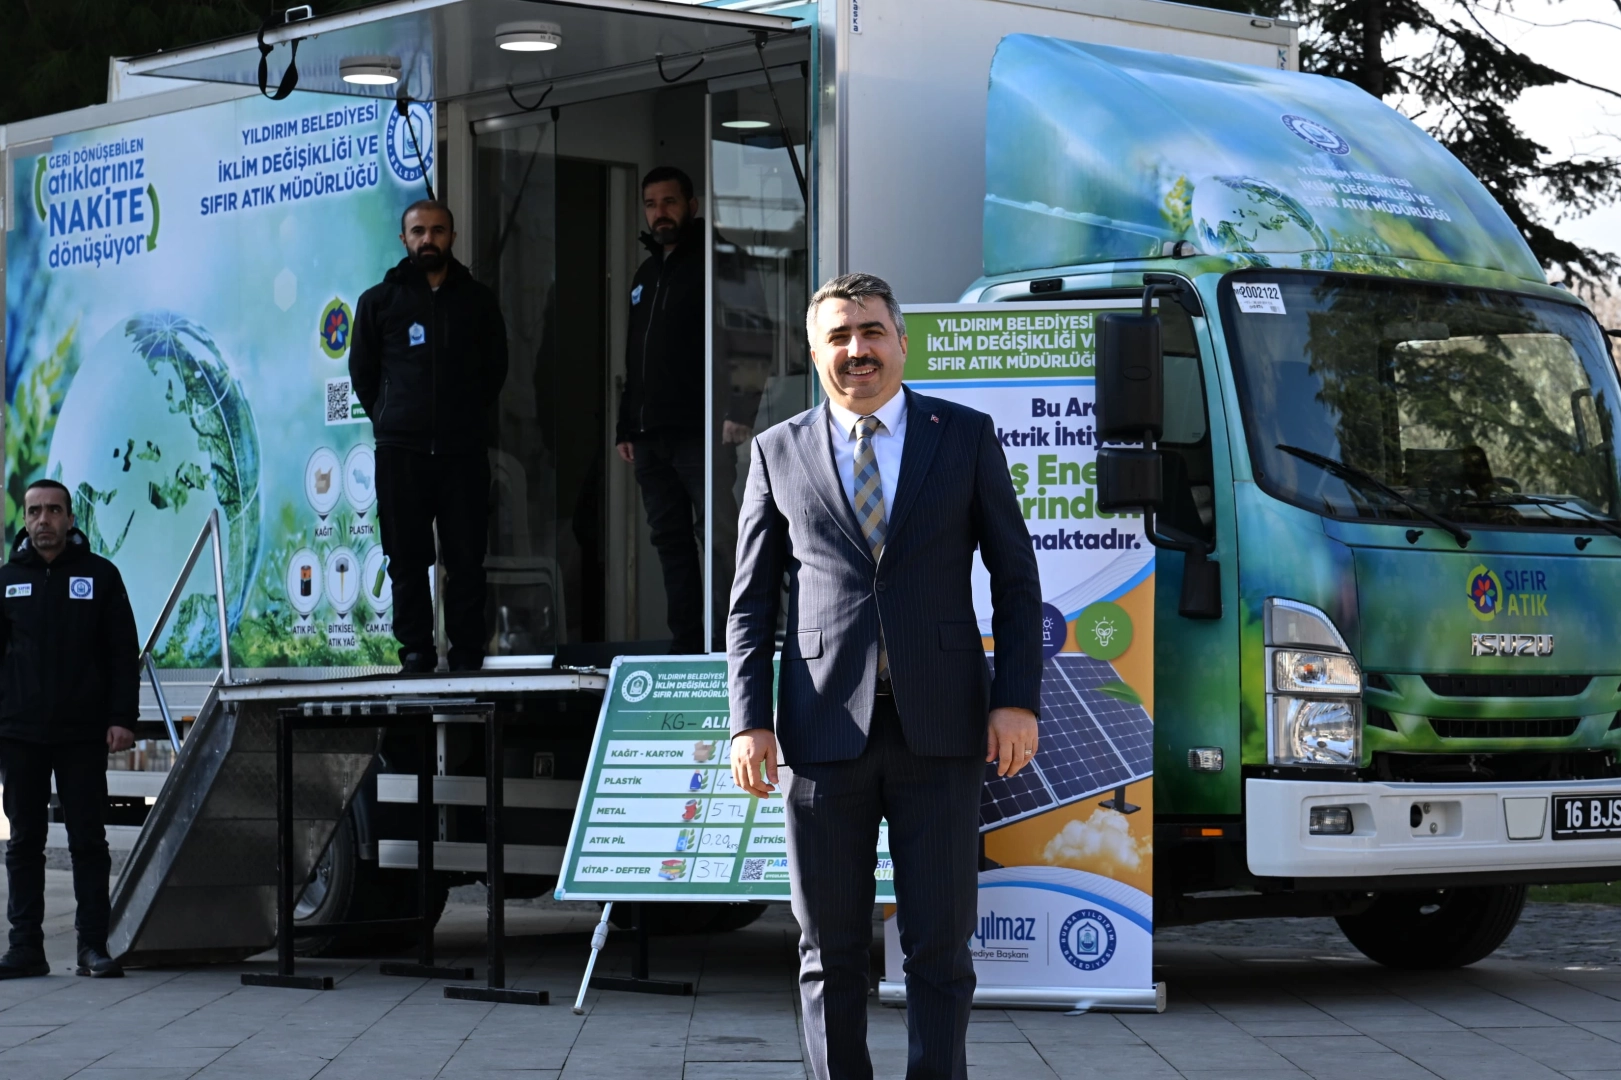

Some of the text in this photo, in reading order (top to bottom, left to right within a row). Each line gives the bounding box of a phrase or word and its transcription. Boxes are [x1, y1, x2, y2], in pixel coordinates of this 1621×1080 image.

[242, 100, 379, 145] YILDIRIM BELEDİYESİ
[49, 138, 144, 169] GERİ DÖNÜŞEBİLEN
[218, 135, 379, 183] İKLİM DEĞİŞİKLİĞİ VE
[48, 158, 144, 196] atıklarınız
[1298, 167, 1413, 188] YILDIRIM BELEDİYESİ
[200, 162, 379, 216] SIFIR ATIK MÜDÜRLÜĞÜ
[1298, 178, 1435, 206] İKLİM DEĞİŞİKLİĞİ VE
[49, 186, 144, 237] NAKİTE
[1303, 195, 1451, 222] SIFIR ATIK MÜDÜRLÜĞÜ
[48, 233, 145, 269] dönüşüyor
[937, 313, 1093, 332] YILDIRIM BELEDİYESİ
[927, 330, 1096, 353] İKLİM DEĞİŞİKLİĞİ V
[927, 356, 966, 371] SIFIR
[968, 355, 1003, 370] ATIK
[1032, 397, 1061, 418] Bu
[314, 526, 333, 537] KAĞIT
[349, 525, 374, 535] PLASTİK
[1504, 570, 1547, 591] SIFIR
[1507, 593, 1549, 617] ATIK
[292, 624, 317, 634] ATIK PİL
[328, 623, 355, 634] BİTKİSEL
[365, 623, 379, 633] CAM
[328, 637, 355, 647] ATIK YAĞ
[1471, 633, 1554, 657] ISUZU
[655, 681, 676, 689] İKLİM
[676, 680, 721, 690] DEĞİŞİKLİĞİ
[687, 672, 725, 680] BELEDİYESİ
[653, 690, 672, 698] SIFIR
[672, 690, 691, 698] ATIK
[610, 748, 638, 758] KAĞIT
[645, 750, 684, 758] KARTON
[604, 776, 642, 785] PLASTİK
[596, 807, 626, 815] METAL
[711, 803, 744, 818] 5 TL
[1565, 799, 1621, 828] 16 BJS
[589, 835, 626, 844] ATIK PİL
[581, 864, 609, 874] KİTAP
[615, 866, 651, 875] DEFTER
[697, 859, 711, 879] 3
[1061, 915, 1077, 943] BURSA
[996, 949, 1029, 960] Başkanı
